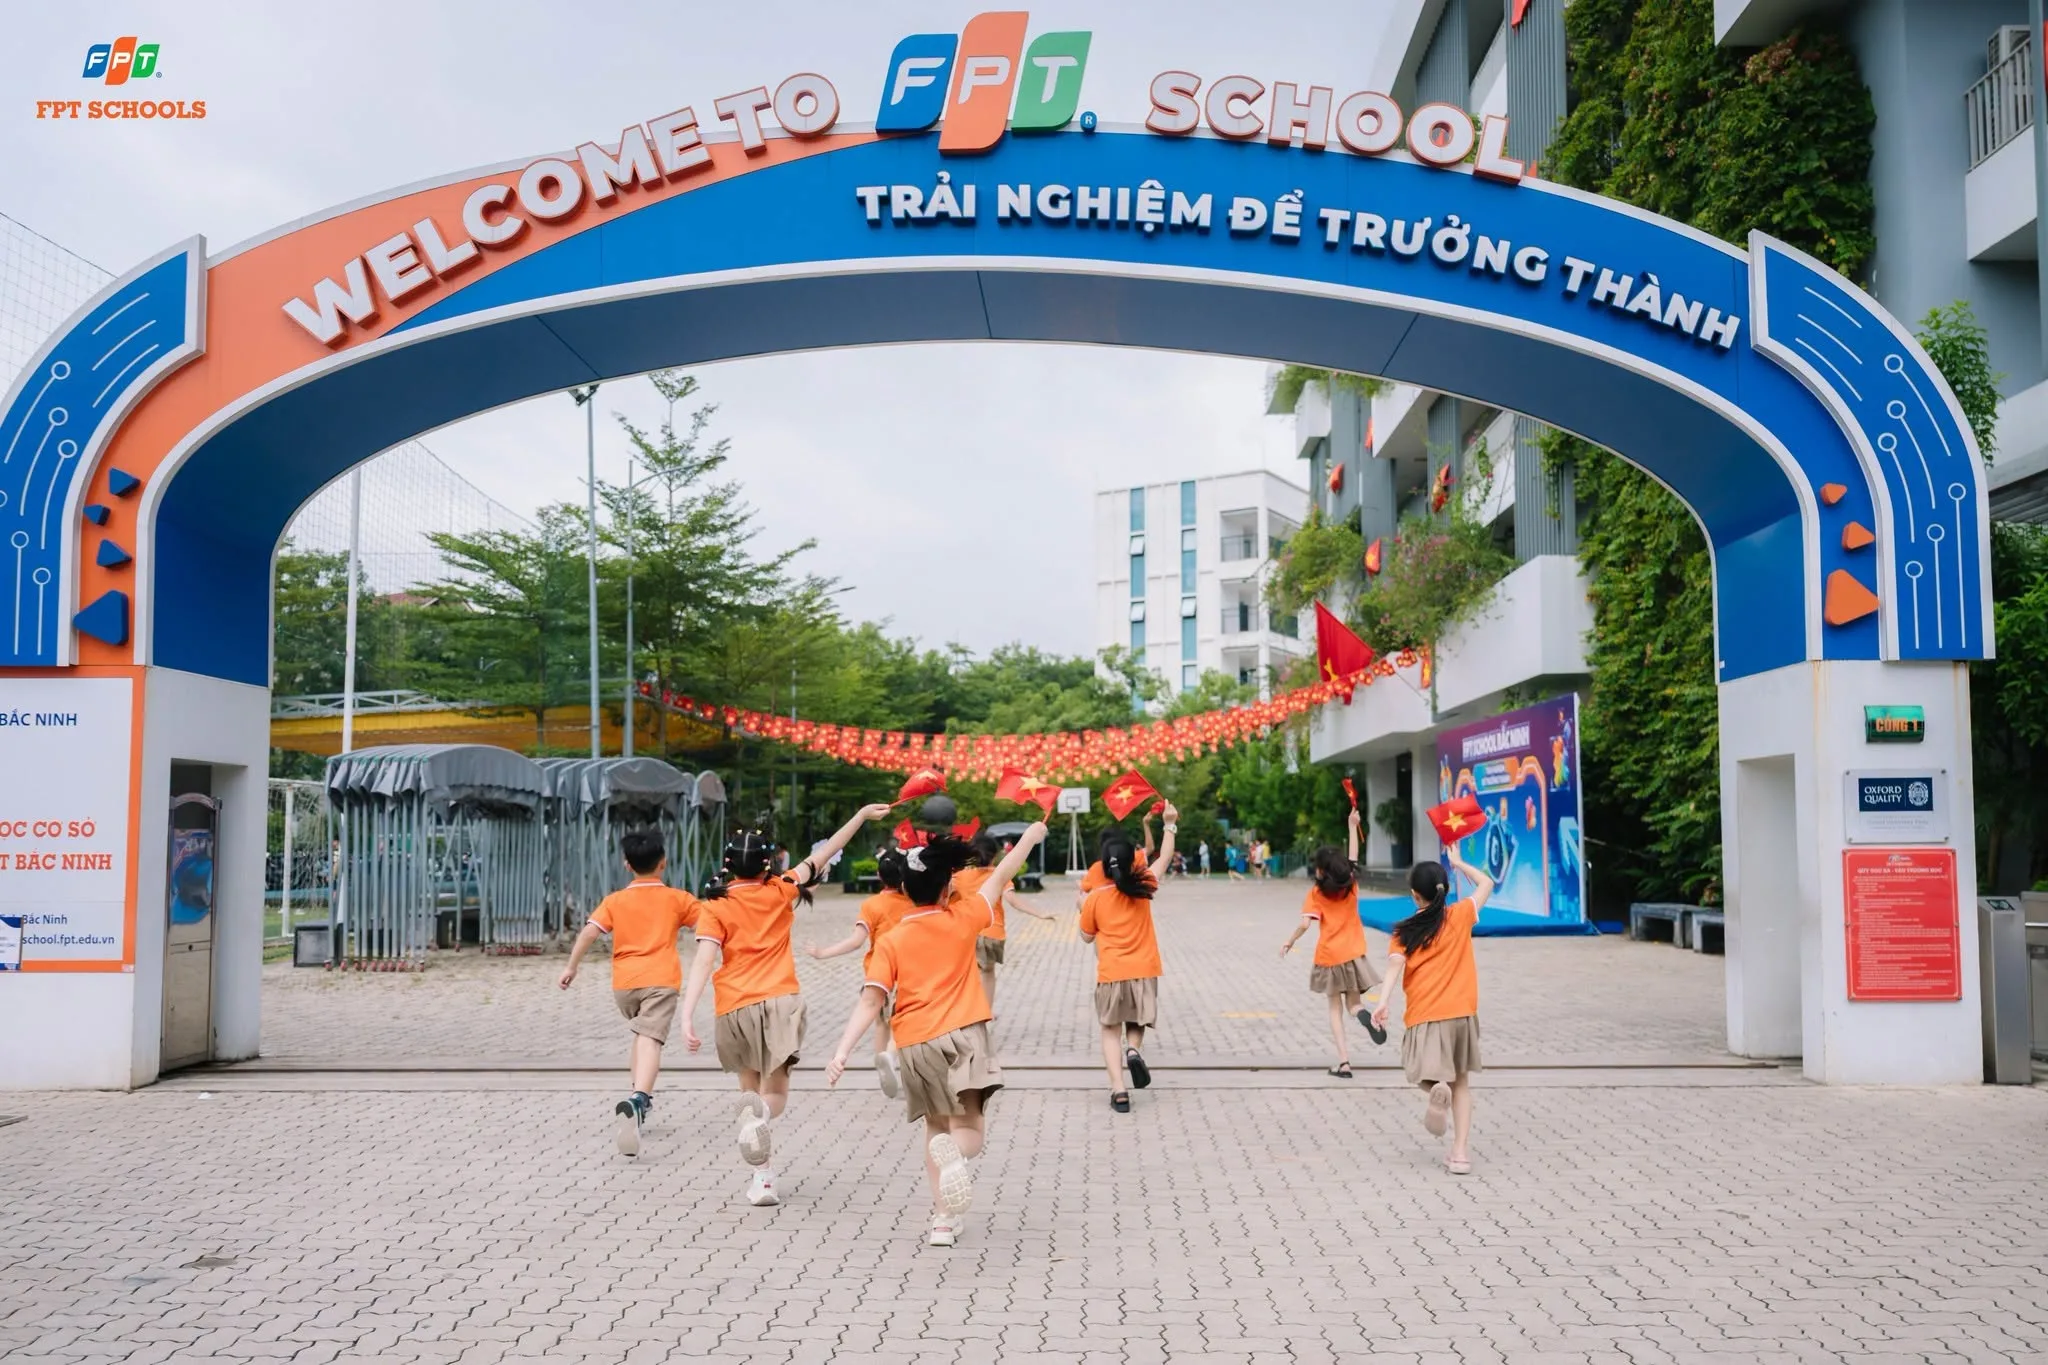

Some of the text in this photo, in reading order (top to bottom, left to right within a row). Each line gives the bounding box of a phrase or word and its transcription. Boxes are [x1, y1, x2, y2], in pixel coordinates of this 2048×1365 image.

[282, 106, 714, 348] WELCOME
[714, 72, 841, 156] TO
[1146, 70, 1525, 184] SCHOOL
[856, 170, 1741, 350] TRẢI NGHIỆM ĐỂ TRƯỞNG THÀNH
[0, 708, 77, 726] BẮC NINH
[1912, 719, 1918, 732] 1
[1864, 786, 1902, 795] OXFORD
[1864, 795, 1902, 804] QUALITY
[15, 848, 56, 870] BẮC
[61, 854, 112, 870] NINH
[43, 914, 68, 924] Ninh
[22, 934, 115, 946] school.fpt.edu.vn
